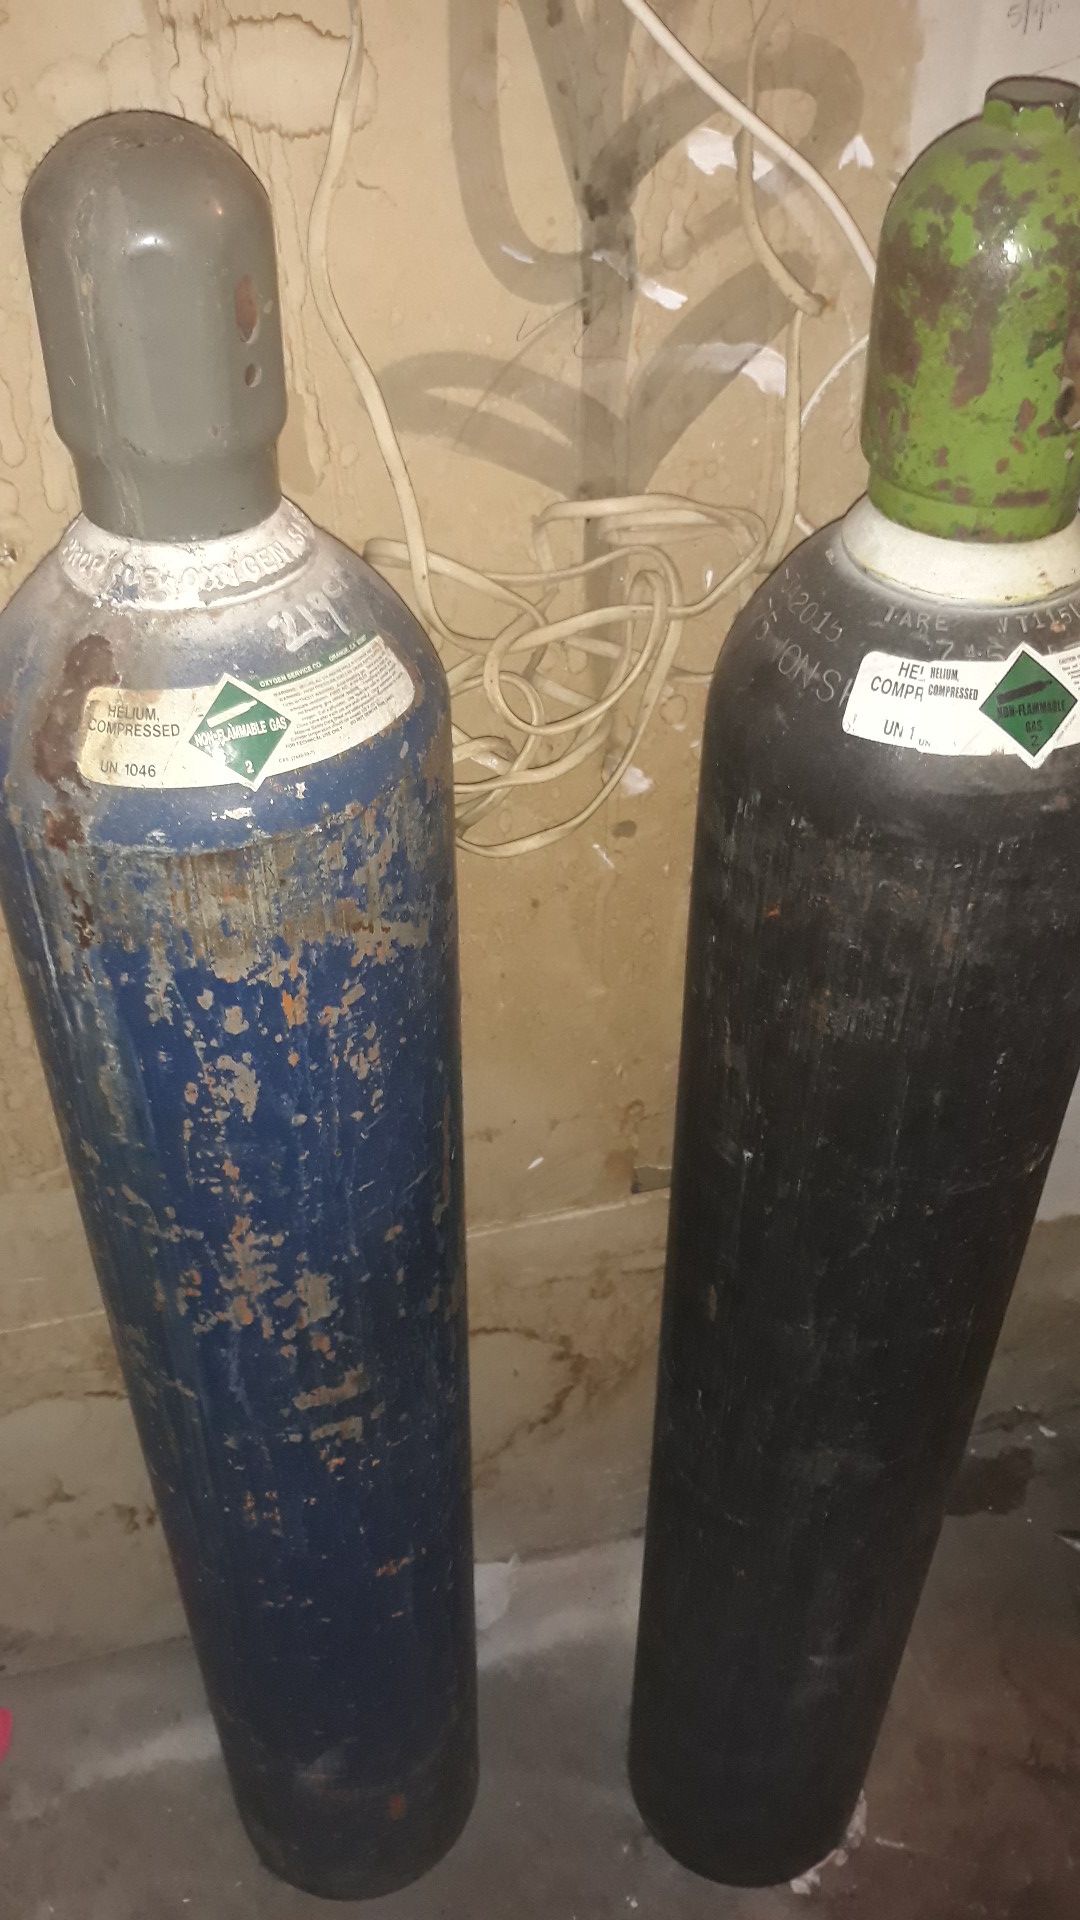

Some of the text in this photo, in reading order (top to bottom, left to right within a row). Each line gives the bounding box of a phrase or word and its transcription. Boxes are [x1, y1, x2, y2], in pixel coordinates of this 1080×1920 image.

[259, 674, 287, 688] OXYGEN
[286, 664, 314, 680] SERVICE
[930, 667, 960, 682] HELIUM,
[928, 683, 979, 701] COMPRESSED
[107, 705, 160, 723] HELIUM,
[88, 719, 180, 738] COMPRESSED
[269, 715, 288, 732] GAS
[883, 719, 904, 738] UN
[1025, 719, 1043, 733] GAS
[1030, 735, 1039, 747] 2
[100, 760, 157, 778] UN 1046
[244, 760, 255, 774] 2
